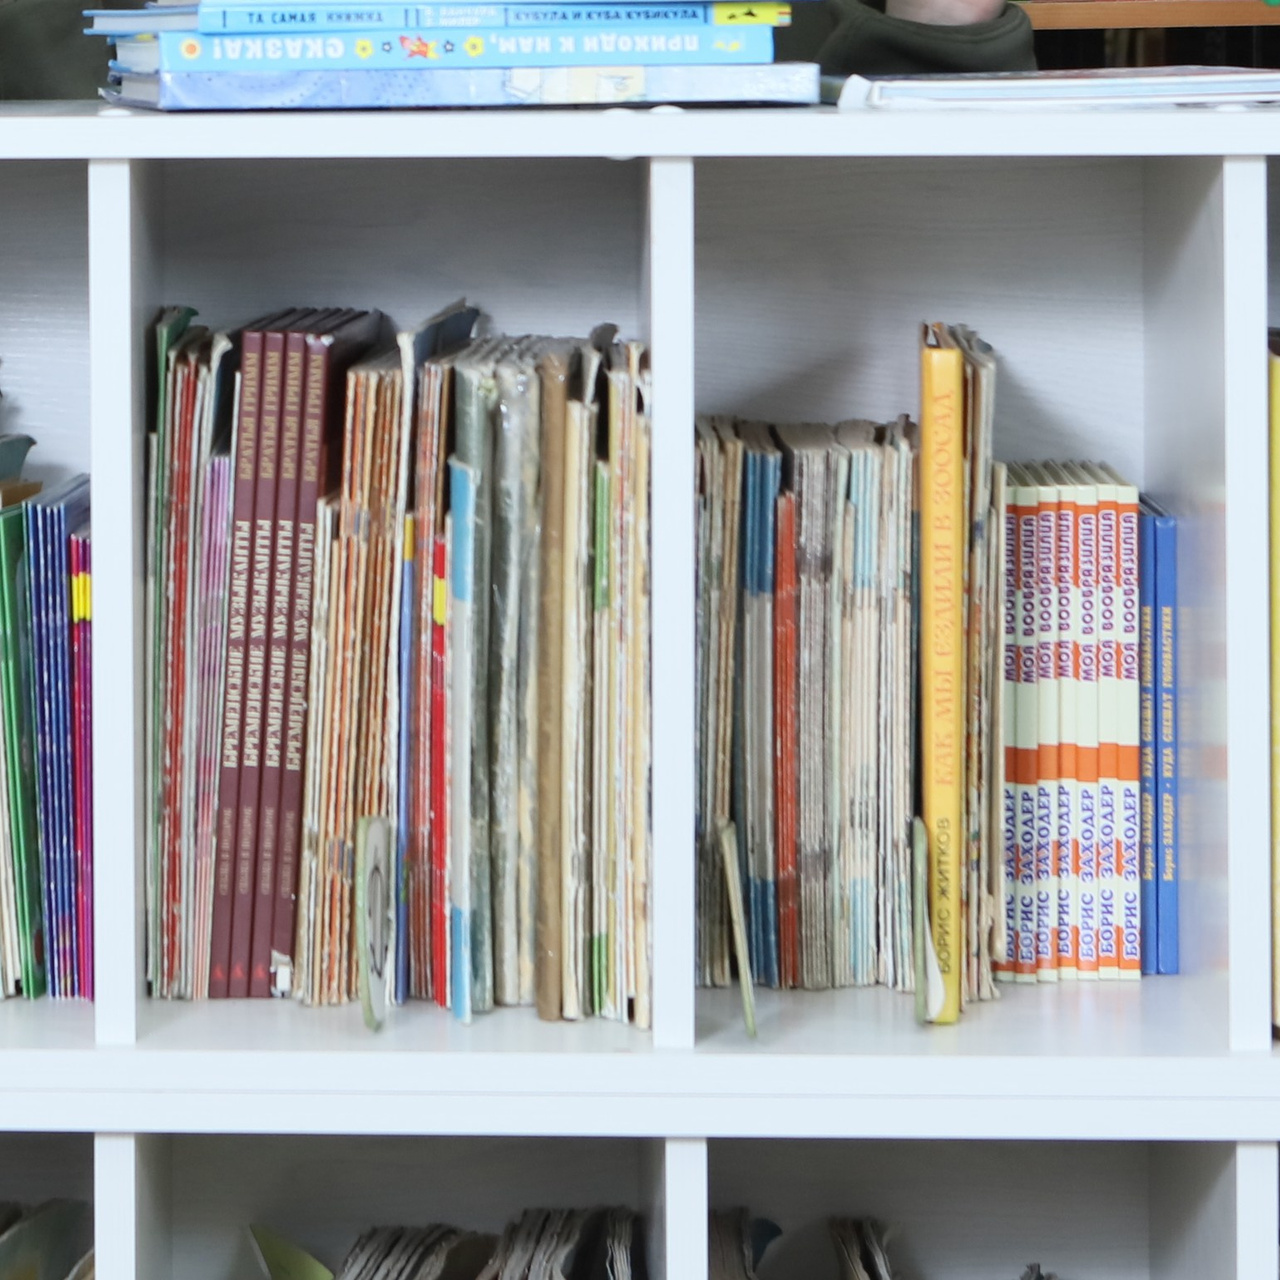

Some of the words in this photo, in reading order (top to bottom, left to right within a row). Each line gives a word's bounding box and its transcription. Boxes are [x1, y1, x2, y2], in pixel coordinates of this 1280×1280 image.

[212, 37, 346, 59] СКАЗКА!
[560, 35, 575, 54] К
[584, 34, 700, 53] ПРИХОДИ
[244, 352, 258, 411] ГРИММ
[286, 351, 301, 410] ГРИММ
[240, 417, 253, 480] БРАТЬЯ
[282, 416, 297, 479] БРАТЬЯ
[229, 520, 251, 640] МУЗЫКАНТЫ
[272, 519, 293, 639] МУЗЫКАНТЫ
[1021, 517, 1034, 636] ВООБРАЗИЛИЯ
[1122, 515, 1135, 633] ВООБРАЗИЛИЯ
[1022, 645, 1034, 683] МОЯ
[1122, 642, 1135, 679] МОЯ
[935, 818, 952, 900] ЖИТКОВ
[1021, 791, 1035, 884] ЗАХОДЕР
[1124, 788, 1137, 881] ЗАХОДЕР
[1021, 895, 1034, 961] БОРИС
[1124, 891, 1138, 957] БОРИС
